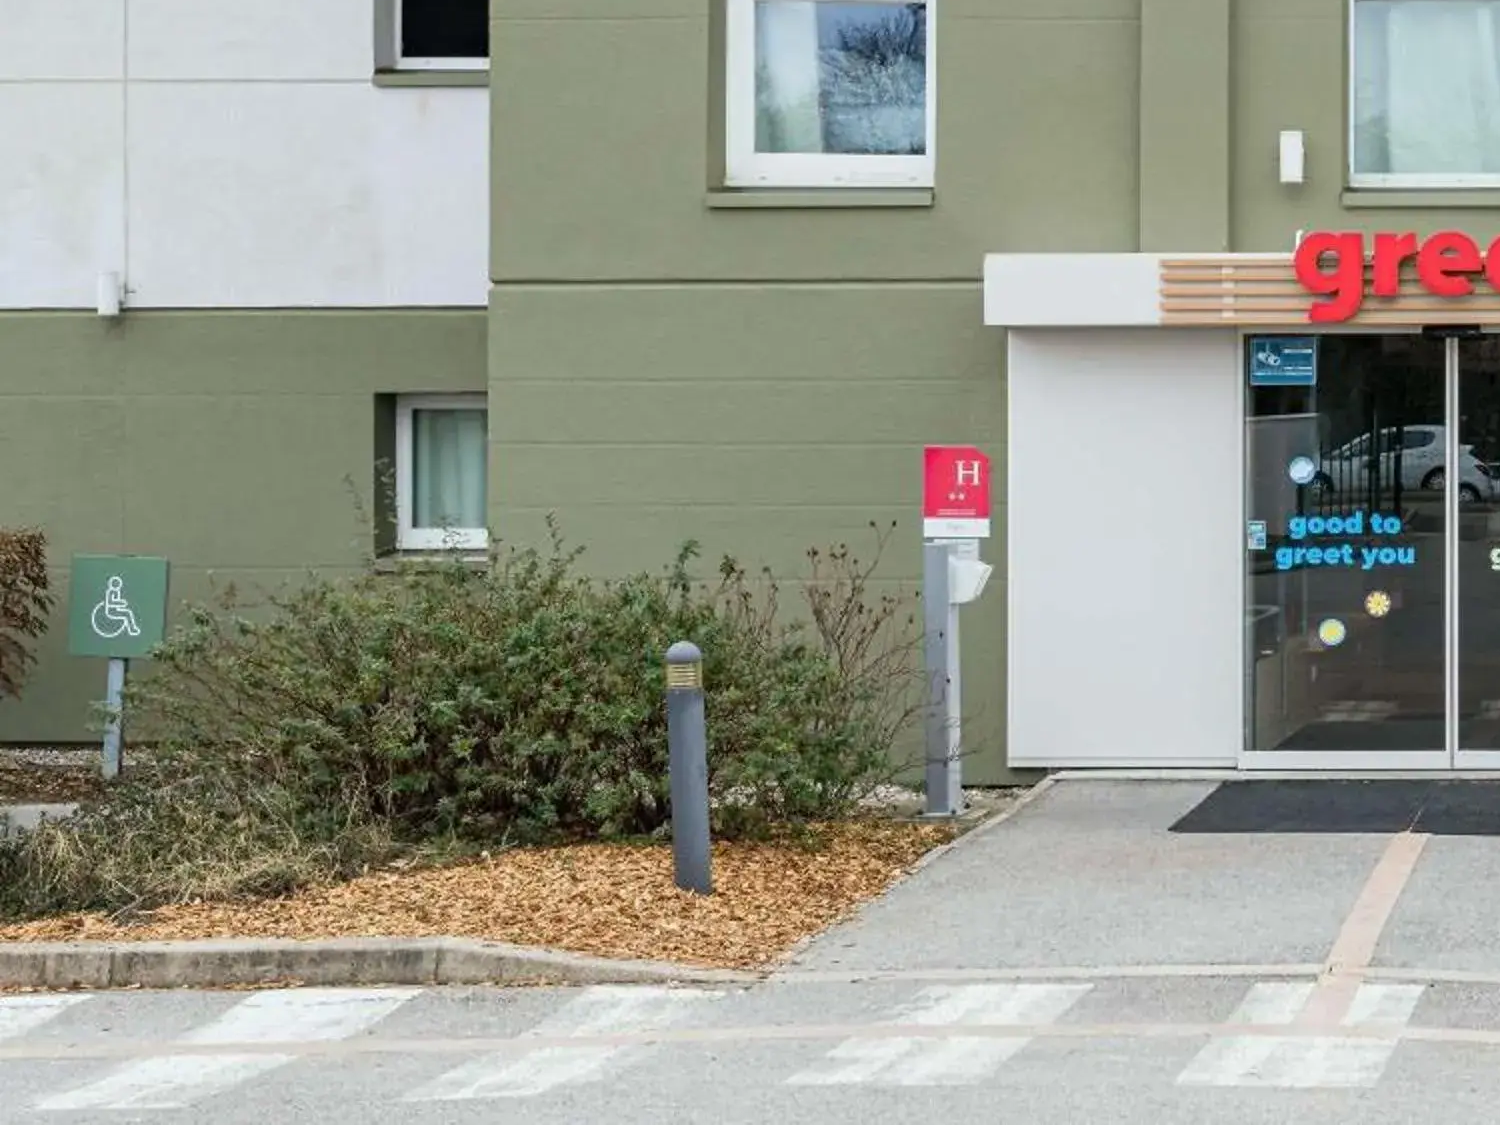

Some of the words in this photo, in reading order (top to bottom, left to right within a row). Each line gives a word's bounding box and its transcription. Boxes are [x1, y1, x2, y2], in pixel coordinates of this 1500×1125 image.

[955, 460, 982, 486] H
[1289, 510, 1363, 539] good
[1370, 513, 1402, 534] to
[1275, 544, 1353, 570] greet
[1361, 546, 1415, 570] you
